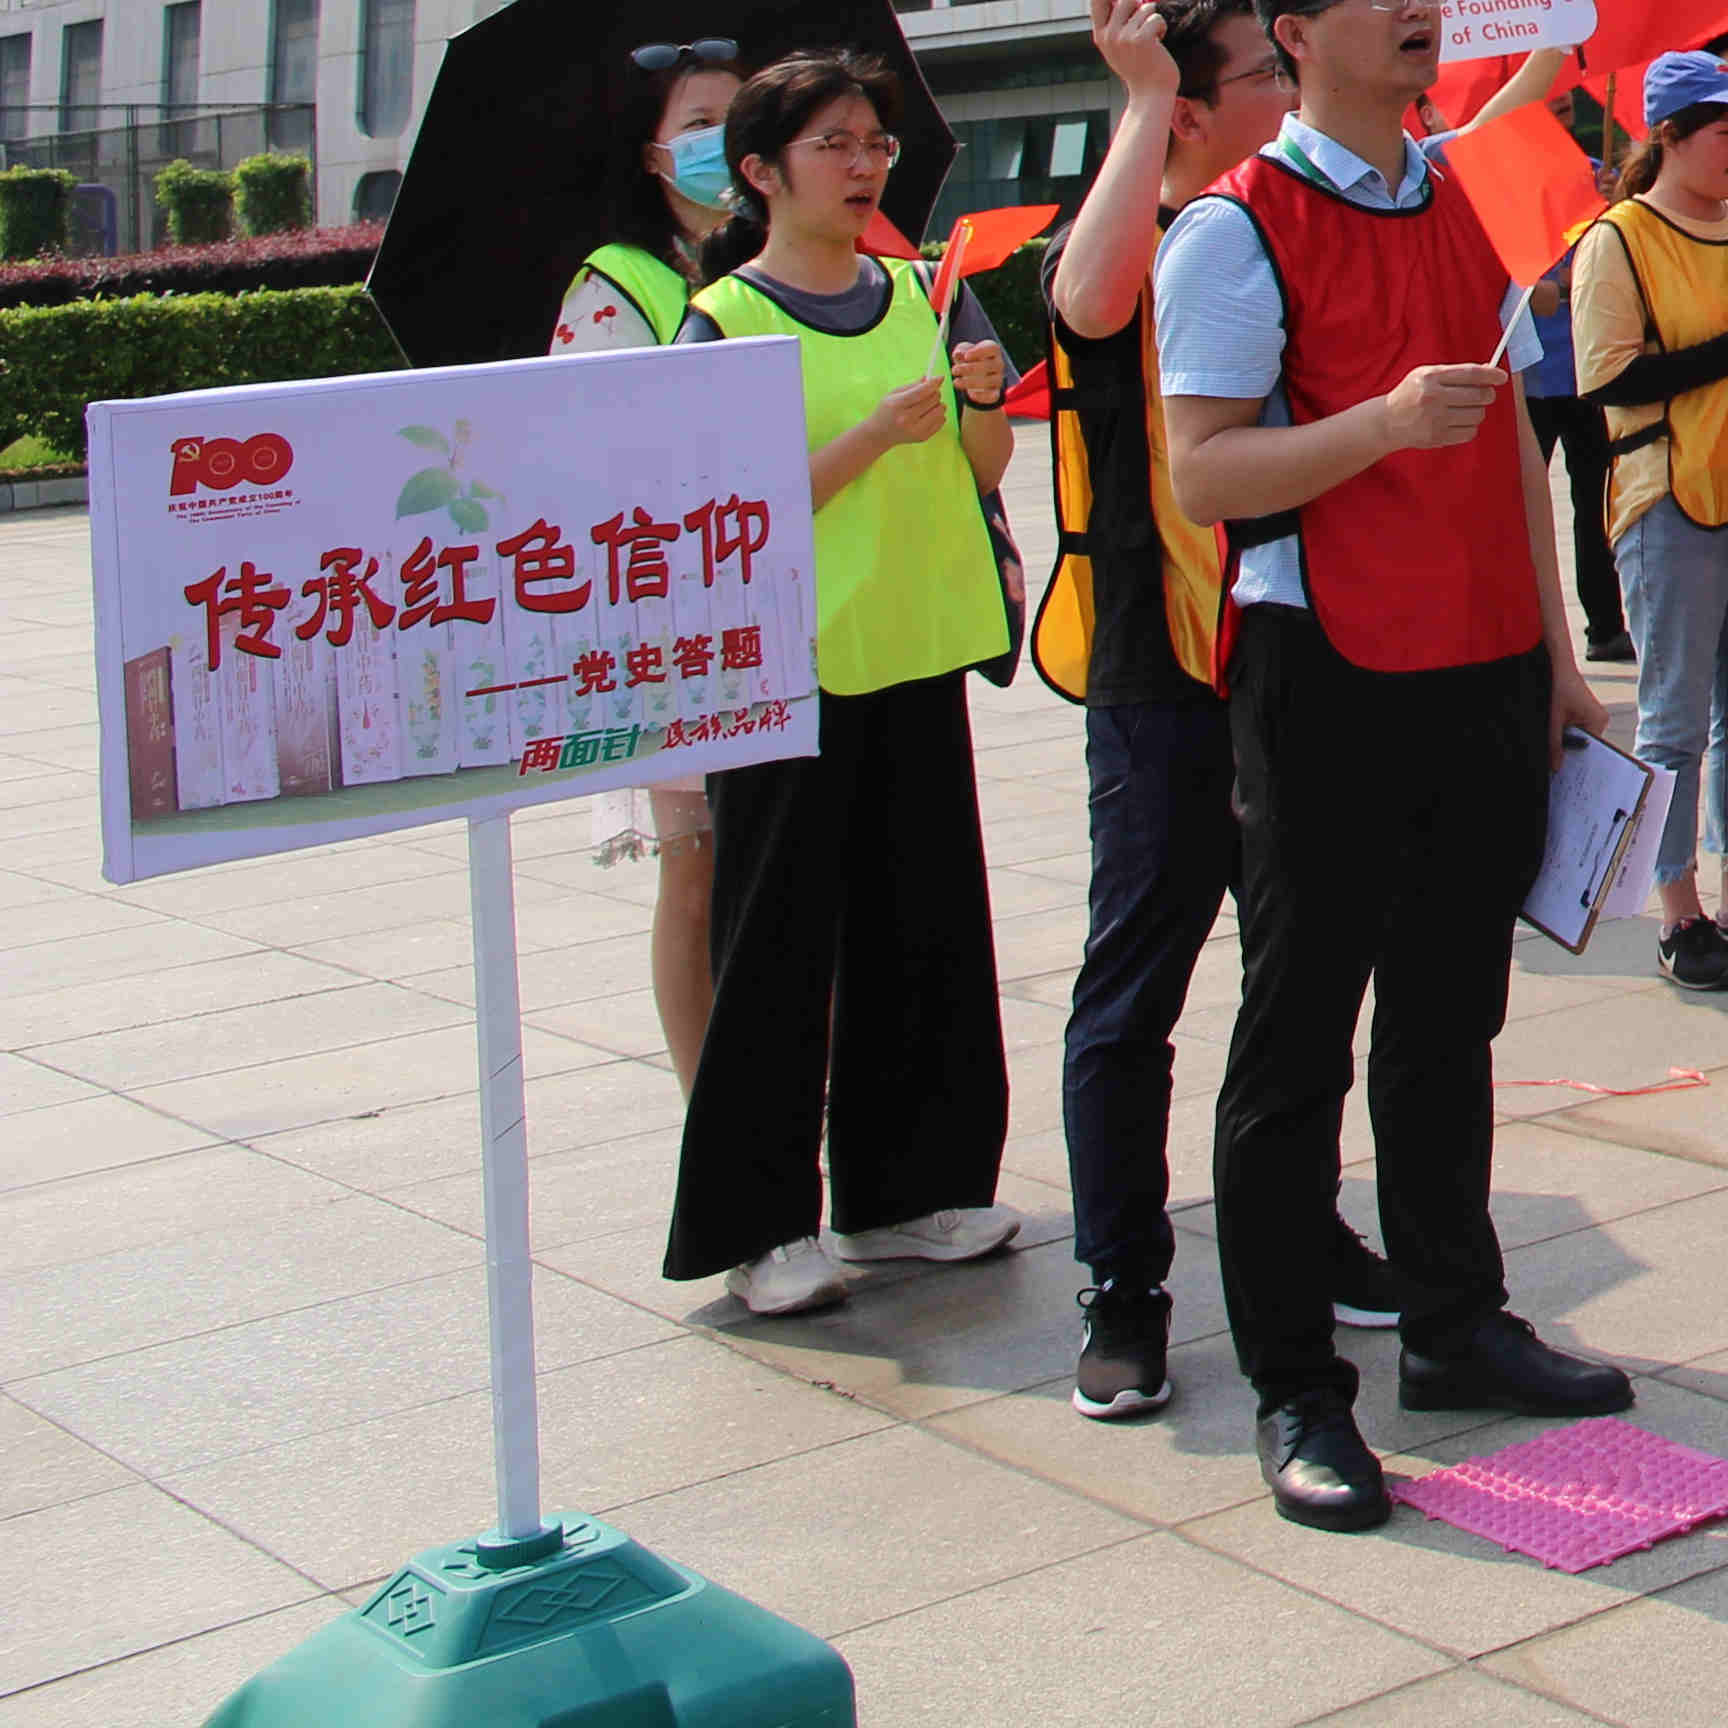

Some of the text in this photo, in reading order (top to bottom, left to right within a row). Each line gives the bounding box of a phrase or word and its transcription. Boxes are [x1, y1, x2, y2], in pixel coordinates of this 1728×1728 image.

[1452, 20, 1539, 45] of China
[184, 493, 770, 672] 传承红色信仰
[519, 724, 642, 776] 两面针
